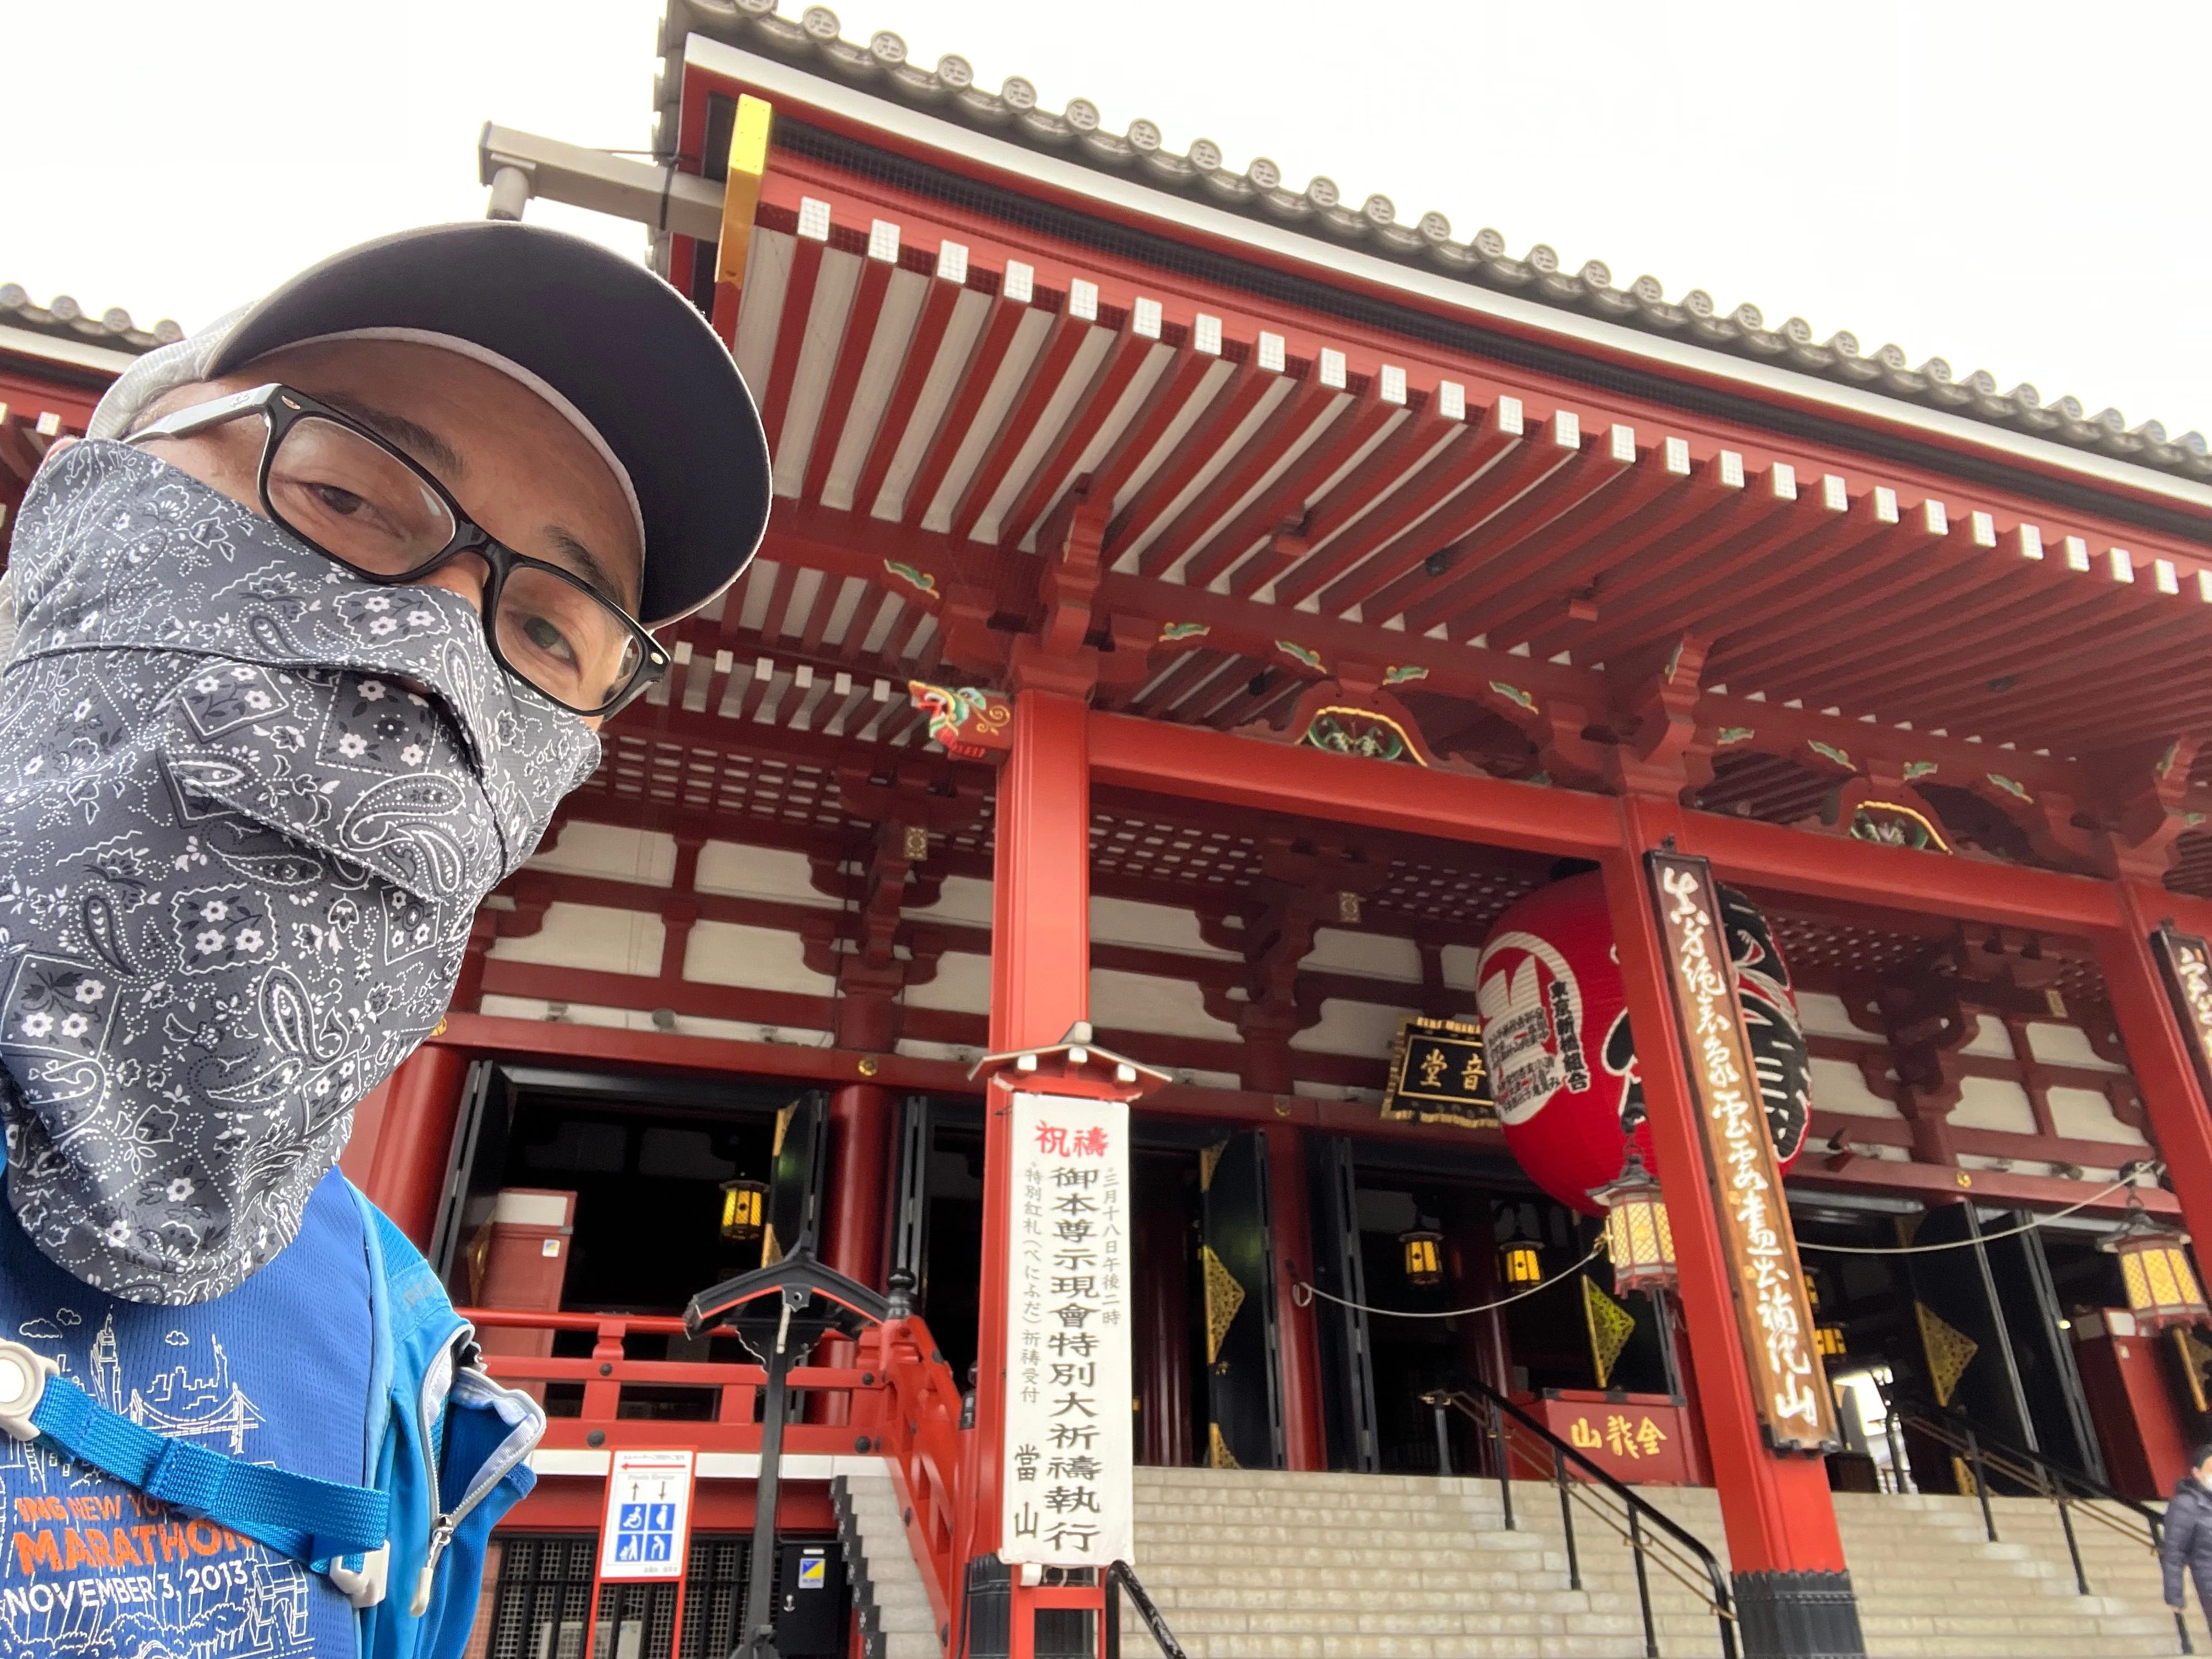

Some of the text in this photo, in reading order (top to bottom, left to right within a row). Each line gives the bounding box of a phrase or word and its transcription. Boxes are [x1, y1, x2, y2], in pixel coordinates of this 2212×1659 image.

[15, 1496, 67, 1522] ING
[66, 1495, 121, 1521] NEW
[4, 1560, 248, 1616] NOVEMBER 3, 2013
